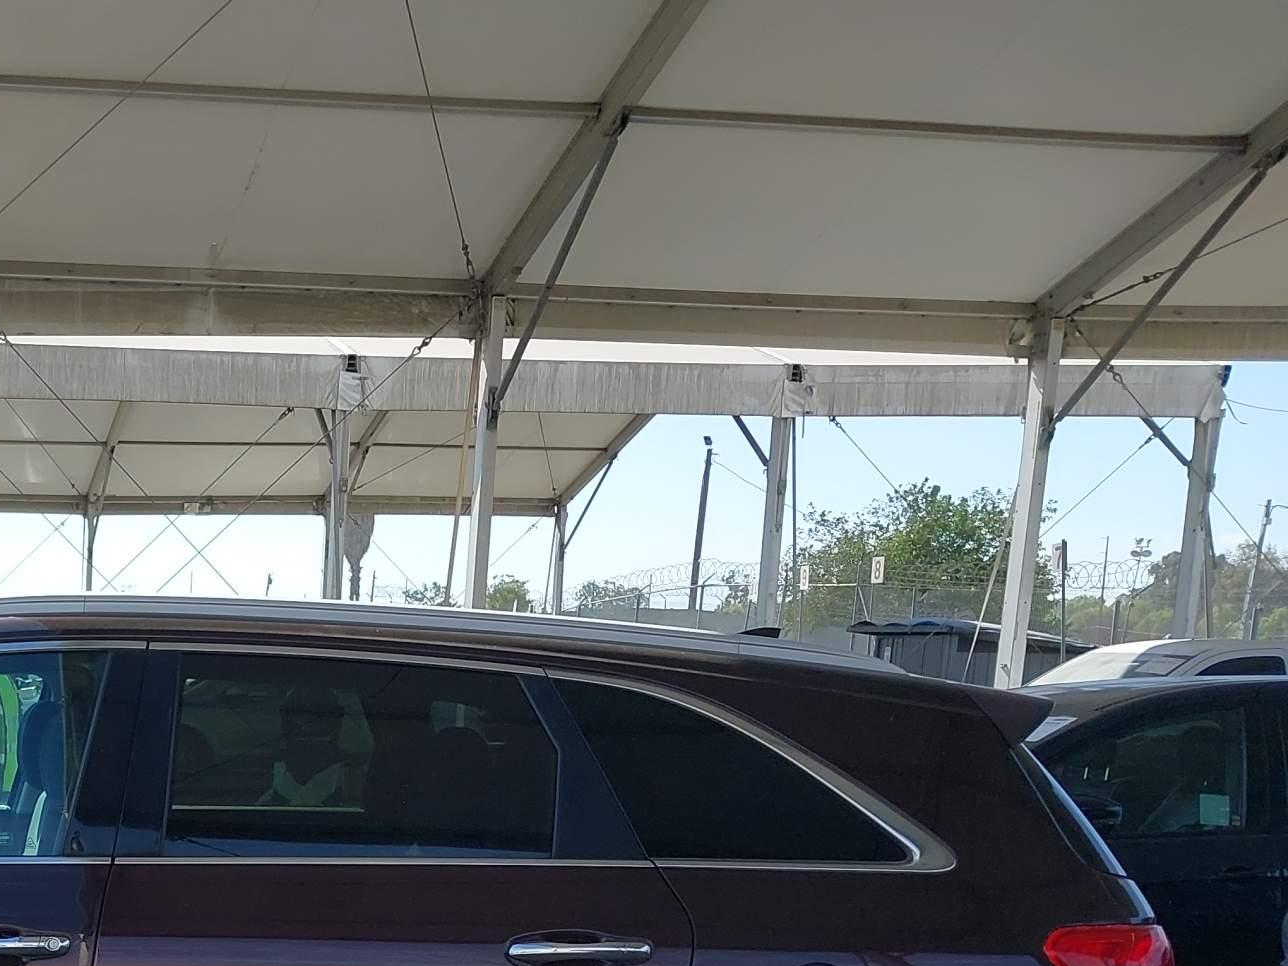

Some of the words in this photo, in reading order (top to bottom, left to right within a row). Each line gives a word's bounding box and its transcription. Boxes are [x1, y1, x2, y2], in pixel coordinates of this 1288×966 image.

[1054, 545, 1062, 569] 7
[801, 568, 808, 587] 9
[873, 559, 882, 580] 8
